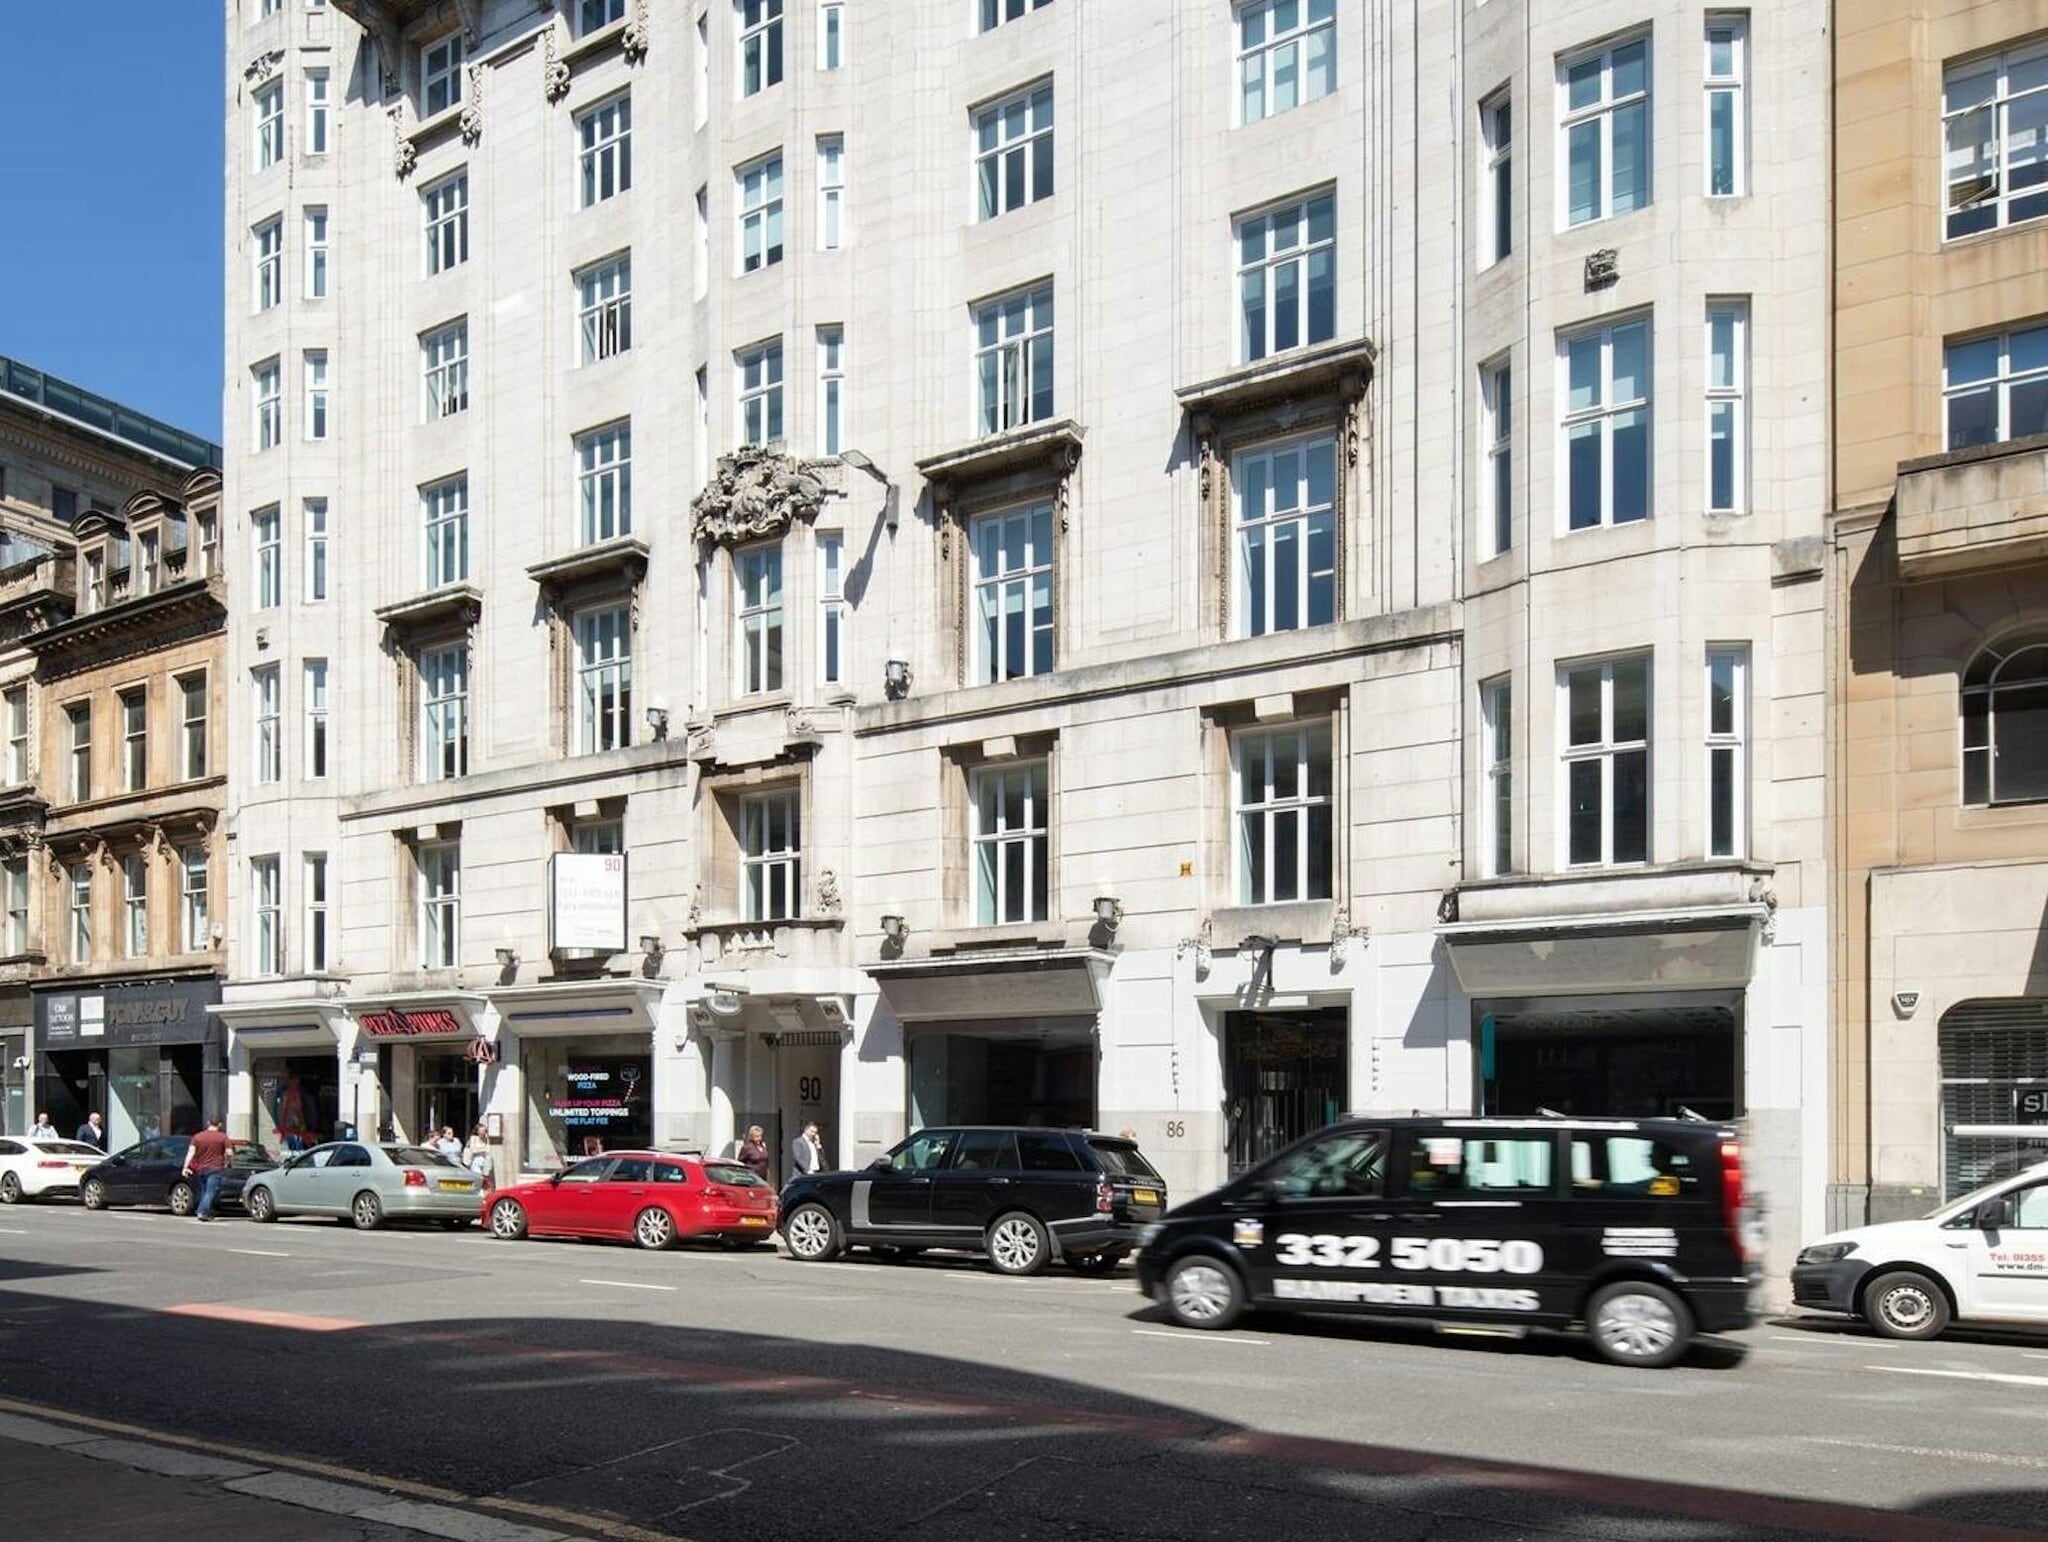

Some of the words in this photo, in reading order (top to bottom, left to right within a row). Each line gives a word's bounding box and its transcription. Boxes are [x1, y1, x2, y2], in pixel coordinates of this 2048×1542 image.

[604, 858, 621, 872] 90
[406, 1011, 460, 1034] PUNKS
[568, 1073, 610, 1081] WOOD-FIRED
[800, 1076, 822, 1101] 90
[601, 1099, 621, 1107] PIZZA
[549, 1108, 590, 1117] UNLIMITED
[591, 1108, 629, 1117] TOPPINGS
[564, 1117, 578, 1125] ONE
[579, 1117, 595, 1125] FLAT
[596, 1117, 609, 1125] FEE
[1166, 1121, 1185, 1138] 86
[1275, 1233, 1381, 1269] 332
[1390, 1236, 1545, 1275] 5050
